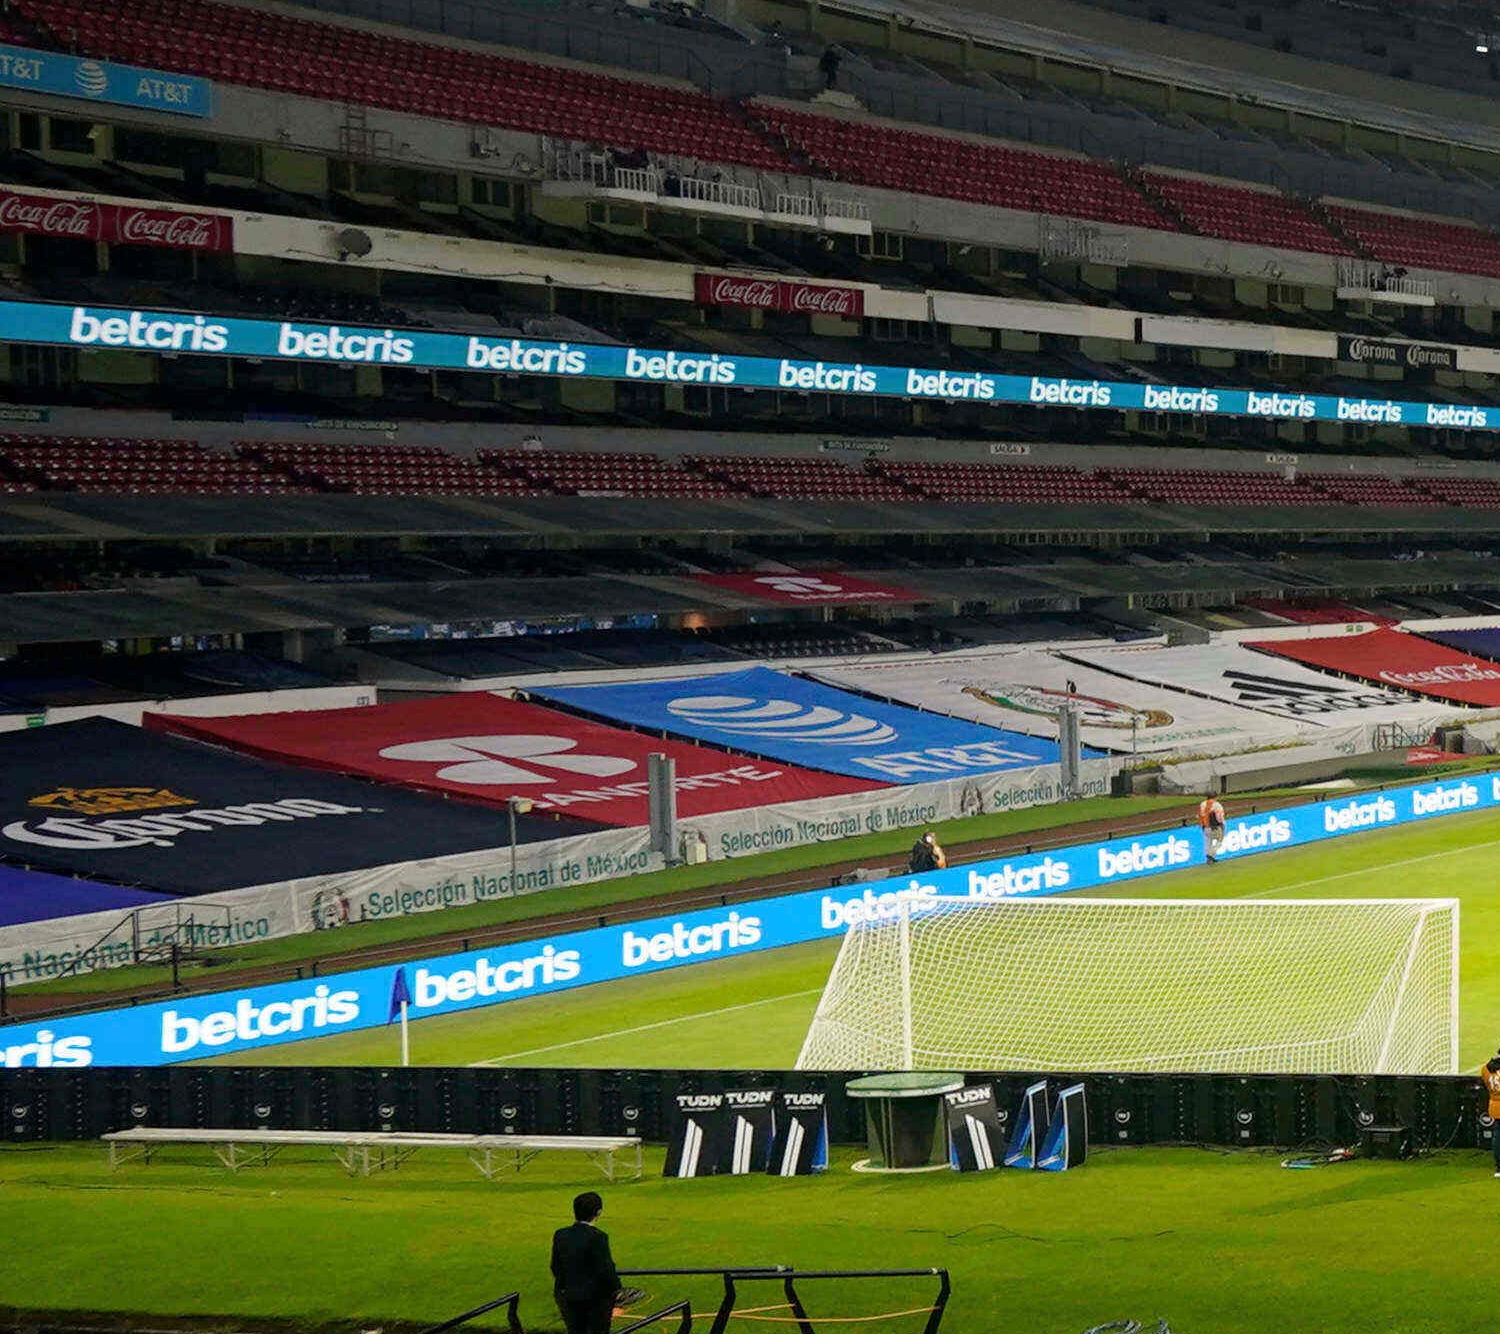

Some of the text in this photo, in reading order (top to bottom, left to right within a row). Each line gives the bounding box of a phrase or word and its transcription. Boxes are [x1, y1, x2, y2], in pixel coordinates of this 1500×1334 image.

[0, 53, 45, 81] T&T
[136, 78, 192, 104] AT&T
[71, 308, 229, 352] betcris
[278, 324, 415, 364] betcris
[467, 338, 586, 375] betcris
[625, 349, 735, 383] betcris
[779, 361, 876, 392] betcris
[907, 370, 995, 400] betcris
[1030, 378, 1111, 405] betcris
[1144, 386, 1219, 411] betcris
[1247, 391, 1315, 417] betcris
[1337, 398, 1401, 422] betcris
[1427, 404, 1487, 427] betcris
[850, 740, 1042, 778] AT&T
[2, 798, 362, 850] Corona
[720, 803, 936, 854] Selección Nacional de México
[368, 848, 649, 920] Selección Nacional de México
[161, 984, 359, 1053] betcris
[415, 945, 580, 1008] betcris
[622, 911, 761, 968] betcris
[821, 880, 938, 929] betcris
[968, 857, 1070, 899] betcris
[1099, 835, 1190, 878] betcris
[1215, 817, 1291, 854] etcris
[1325, 796, 1396, 831] betcris
[1413, 781, 1478, 815] betcris
[676, 1093, 723, 1108] TUDN
[725, 1090, 773, 1105] TUDN
[783, 1092, 825, 1107] TUDN
[945, 1087, 993, 1108] TUDN
